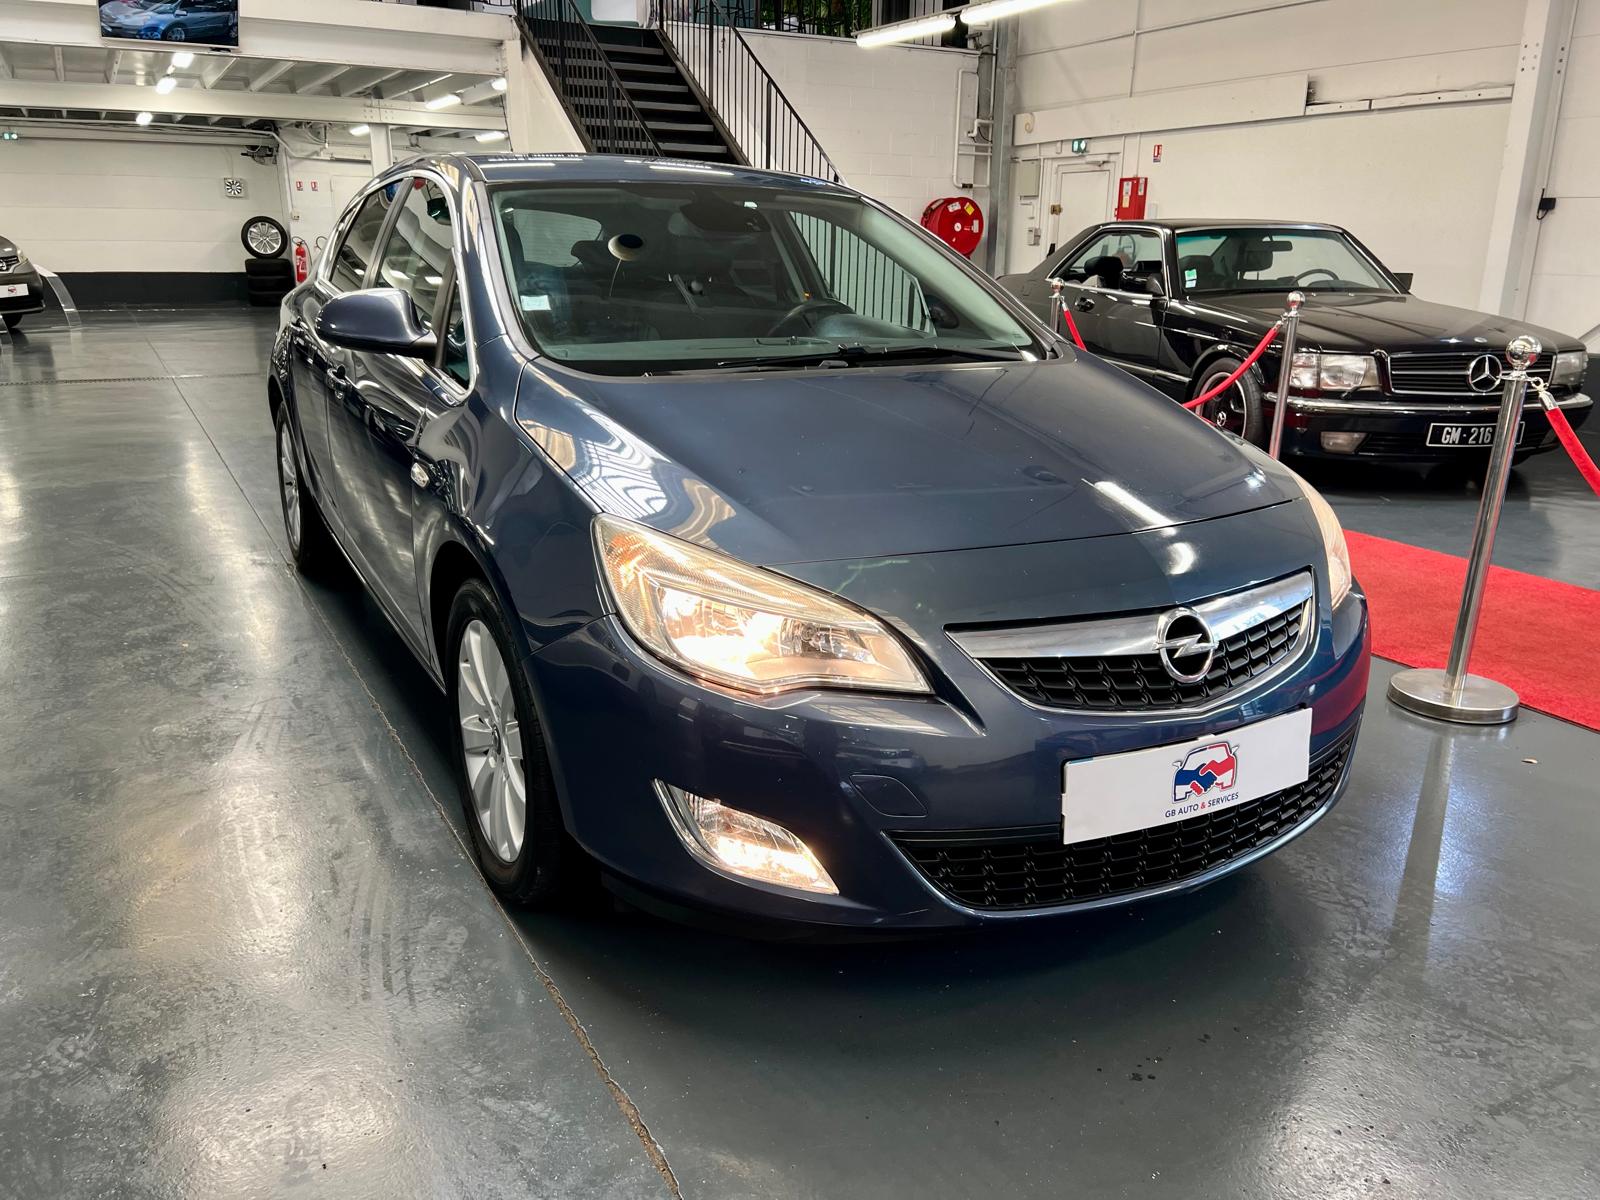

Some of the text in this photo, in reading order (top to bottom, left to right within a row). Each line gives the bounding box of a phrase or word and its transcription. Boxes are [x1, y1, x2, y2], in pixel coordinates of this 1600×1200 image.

[1165, 792, 1239, 818] GB AUTO & SERVICES
